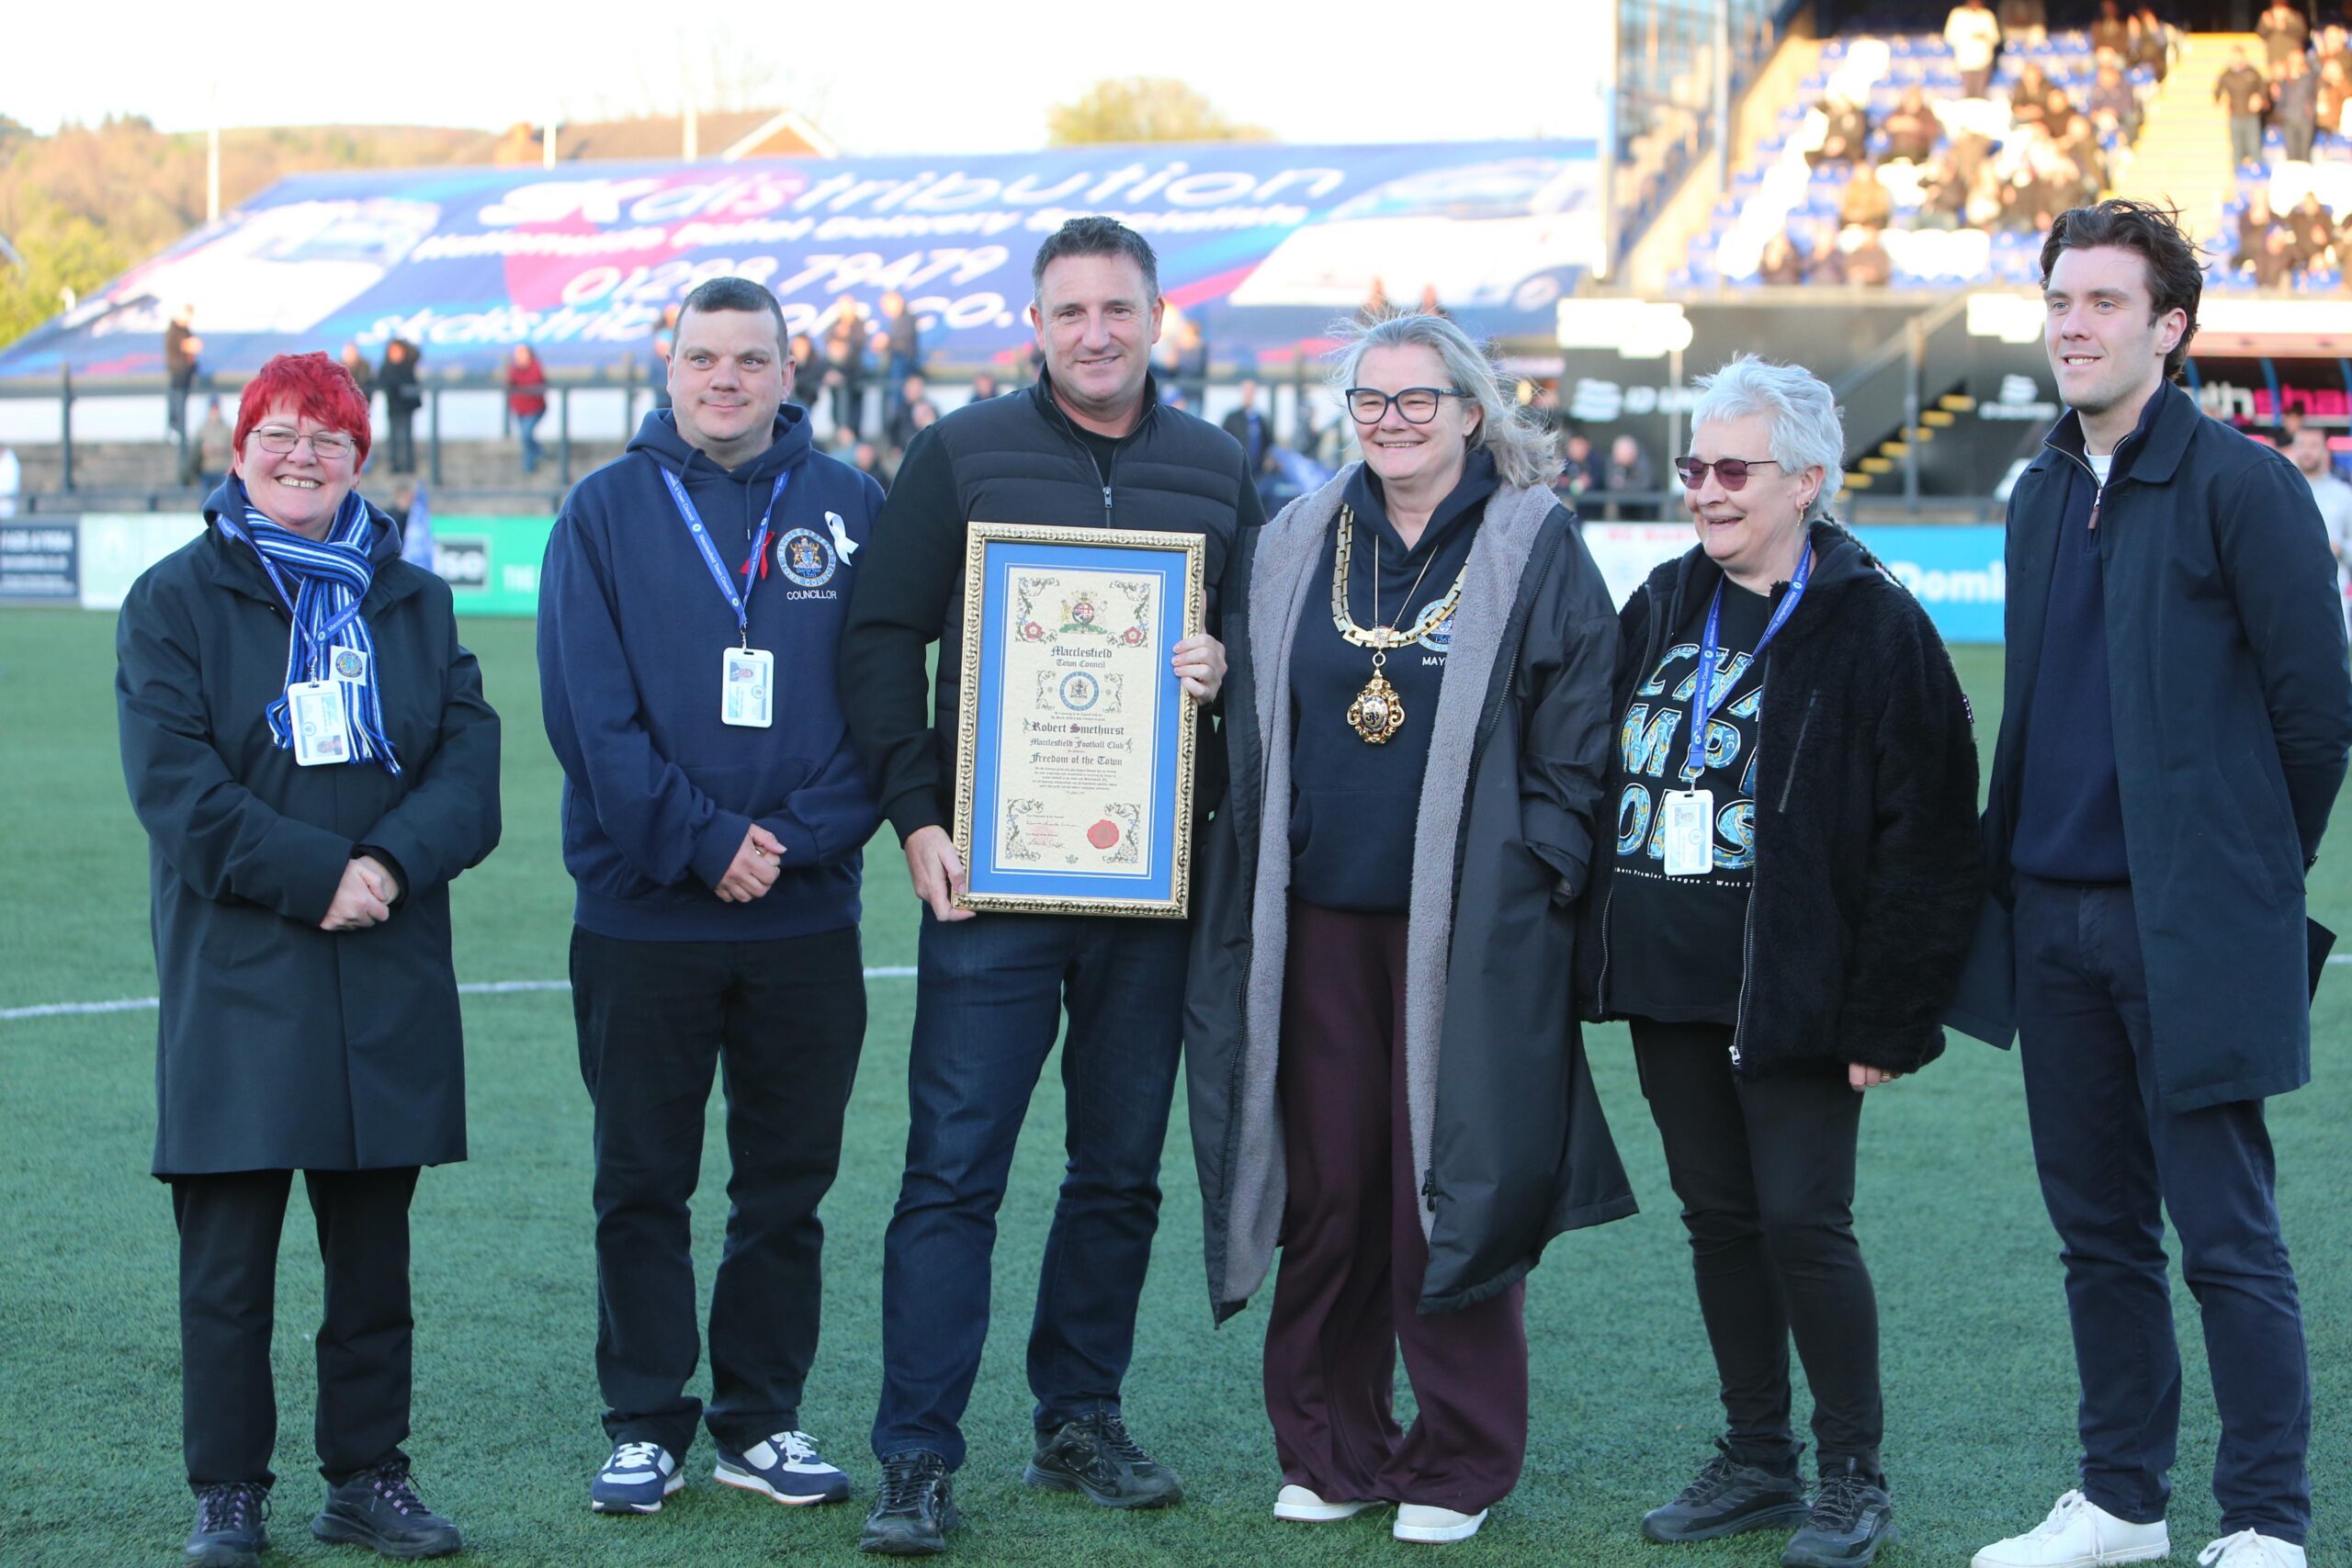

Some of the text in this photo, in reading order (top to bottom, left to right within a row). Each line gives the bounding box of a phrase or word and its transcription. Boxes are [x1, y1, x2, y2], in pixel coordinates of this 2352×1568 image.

[699, 534, 717, 563] Macclesfield
[720, 576, 733, 595] Council
[786, 589, 837, 600] COUNCILLOR
[1050, 645, 1113, 659] Macclesfield
[1056, 659, 1106, 669] Town Council
[1696, 694, 1705, 726] Macclesfield
[1702, 661, 1710, 680] Council
[1032, 721, 1125, 736] Robert Smethurst
[1030, 738, 1125, 750] Macclesfield Football Club
[1029, 752, 1123, 767] Freedom of the Town
[1634, 869, 1662, 879] Premier
[1666, 875, 1701, 884] League
